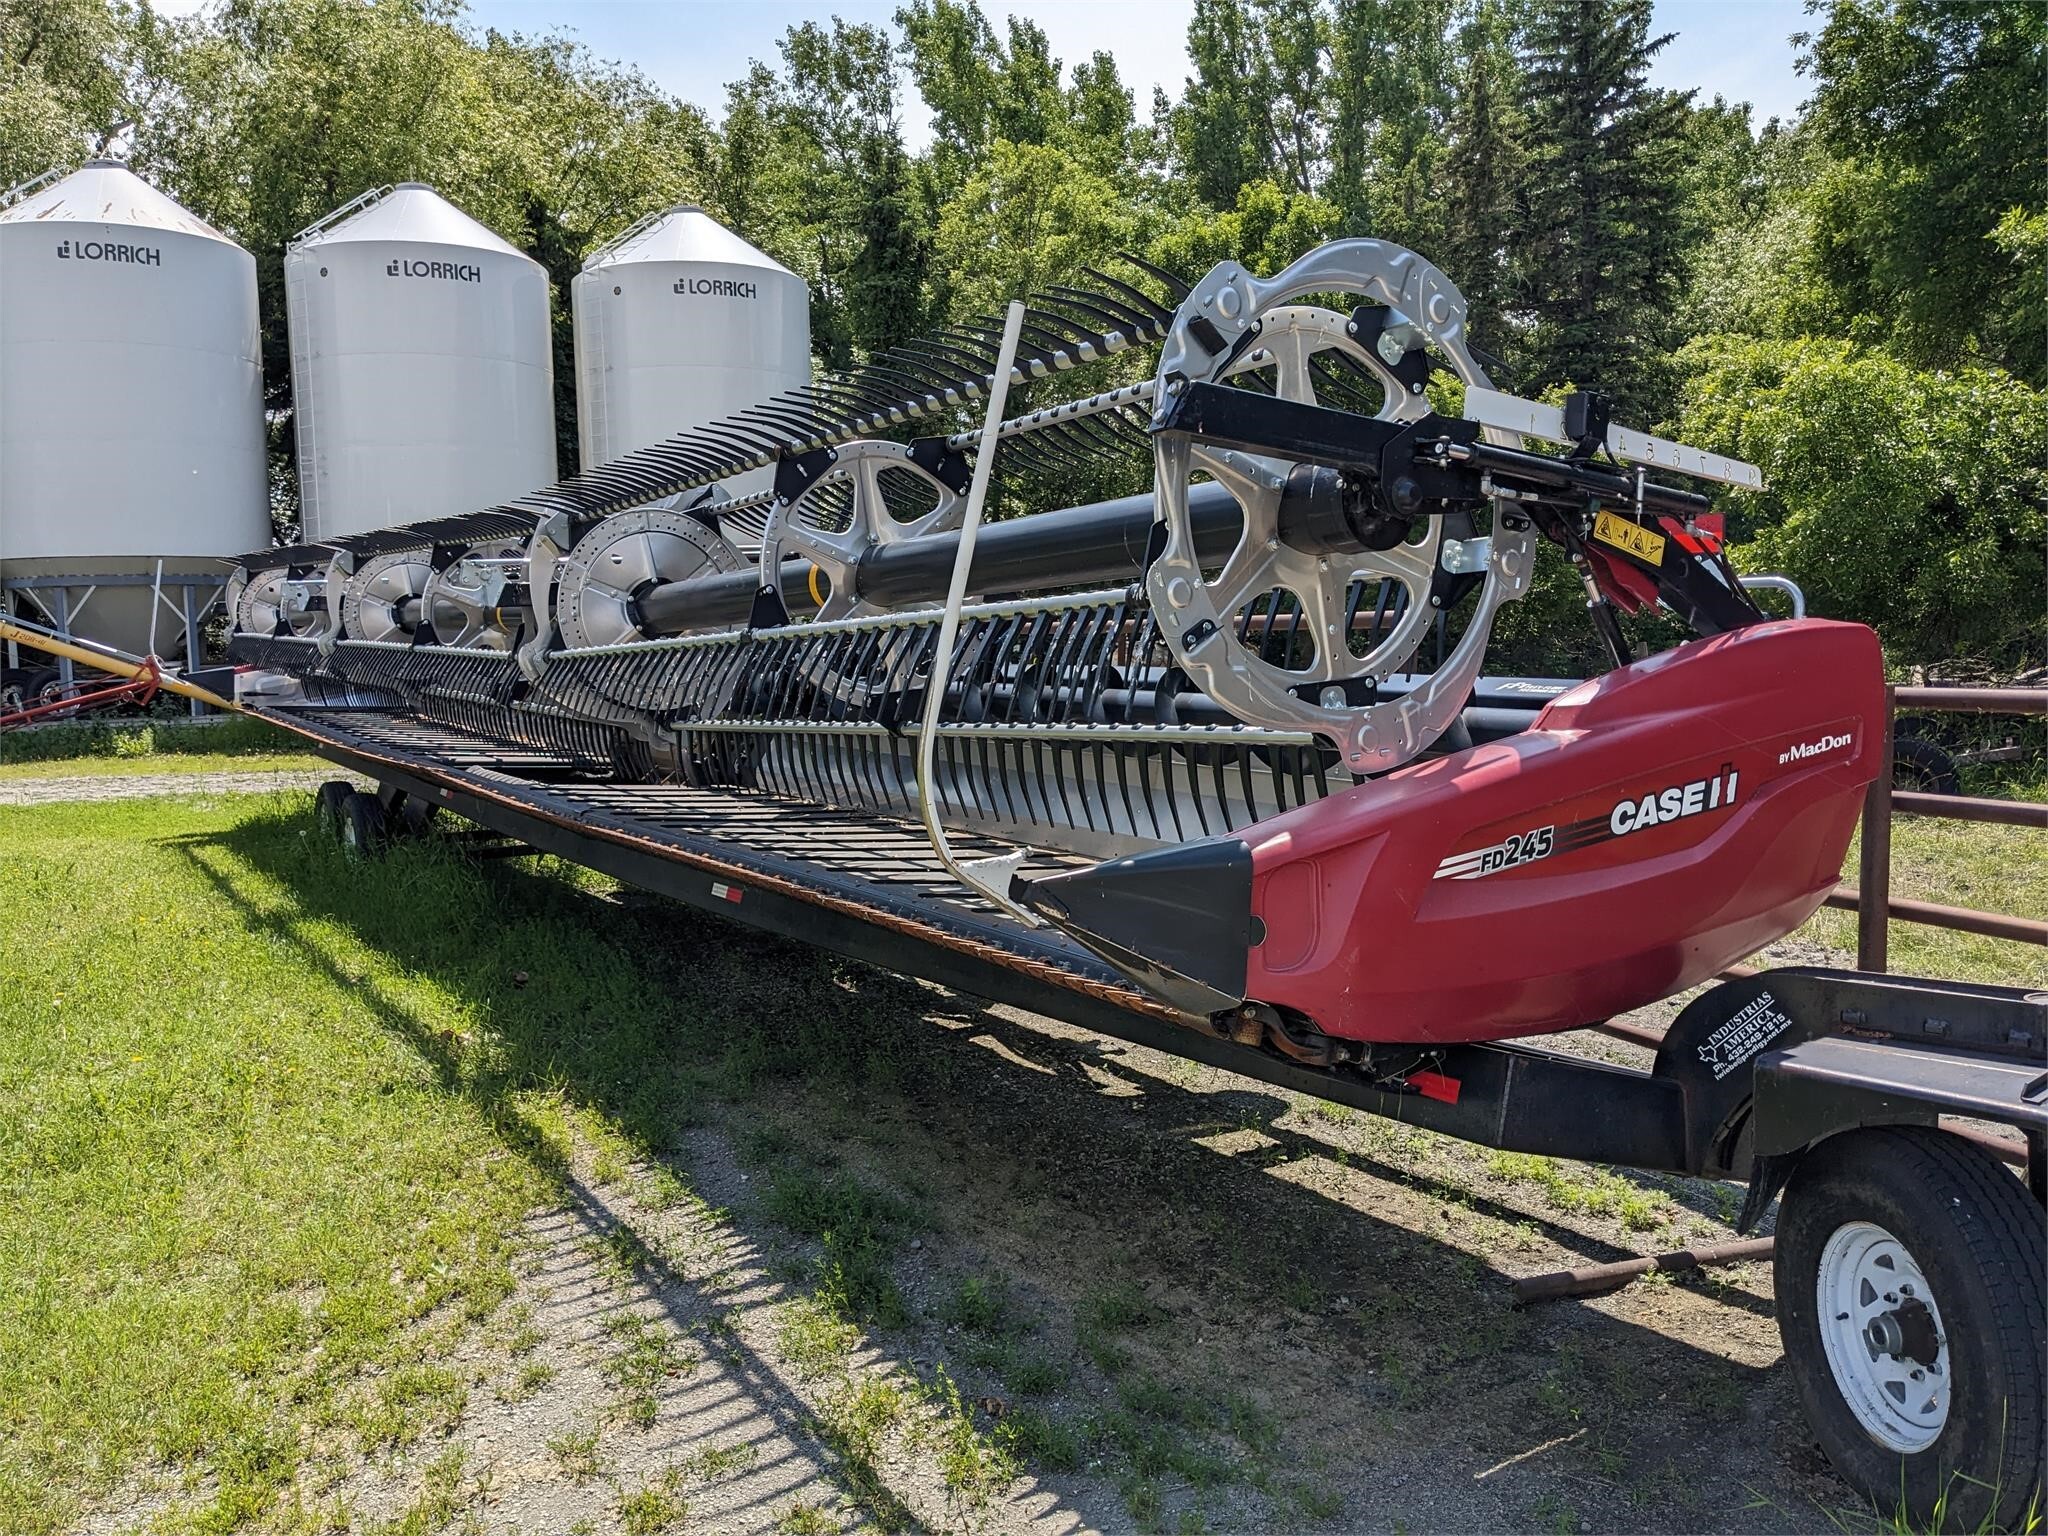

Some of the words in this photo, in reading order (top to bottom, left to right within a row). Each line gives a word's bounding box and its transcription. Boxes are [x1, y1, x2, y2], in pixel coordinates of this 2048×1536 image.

[75, 241, 161, 266] LORRICH
[403, 260, 481, 283] LORRICH
[688, 278, 756, 299] LORRICH
[1779, 751, 1790, 765] BY
[1790, 733, 1852, 761] MacDon
[1707, 991, 1772, 1046] INDUSTRIAS
[1722, 1008, 1776, 1054] AMERICA
[1712, 1061, 1728, 1074] Ph.
